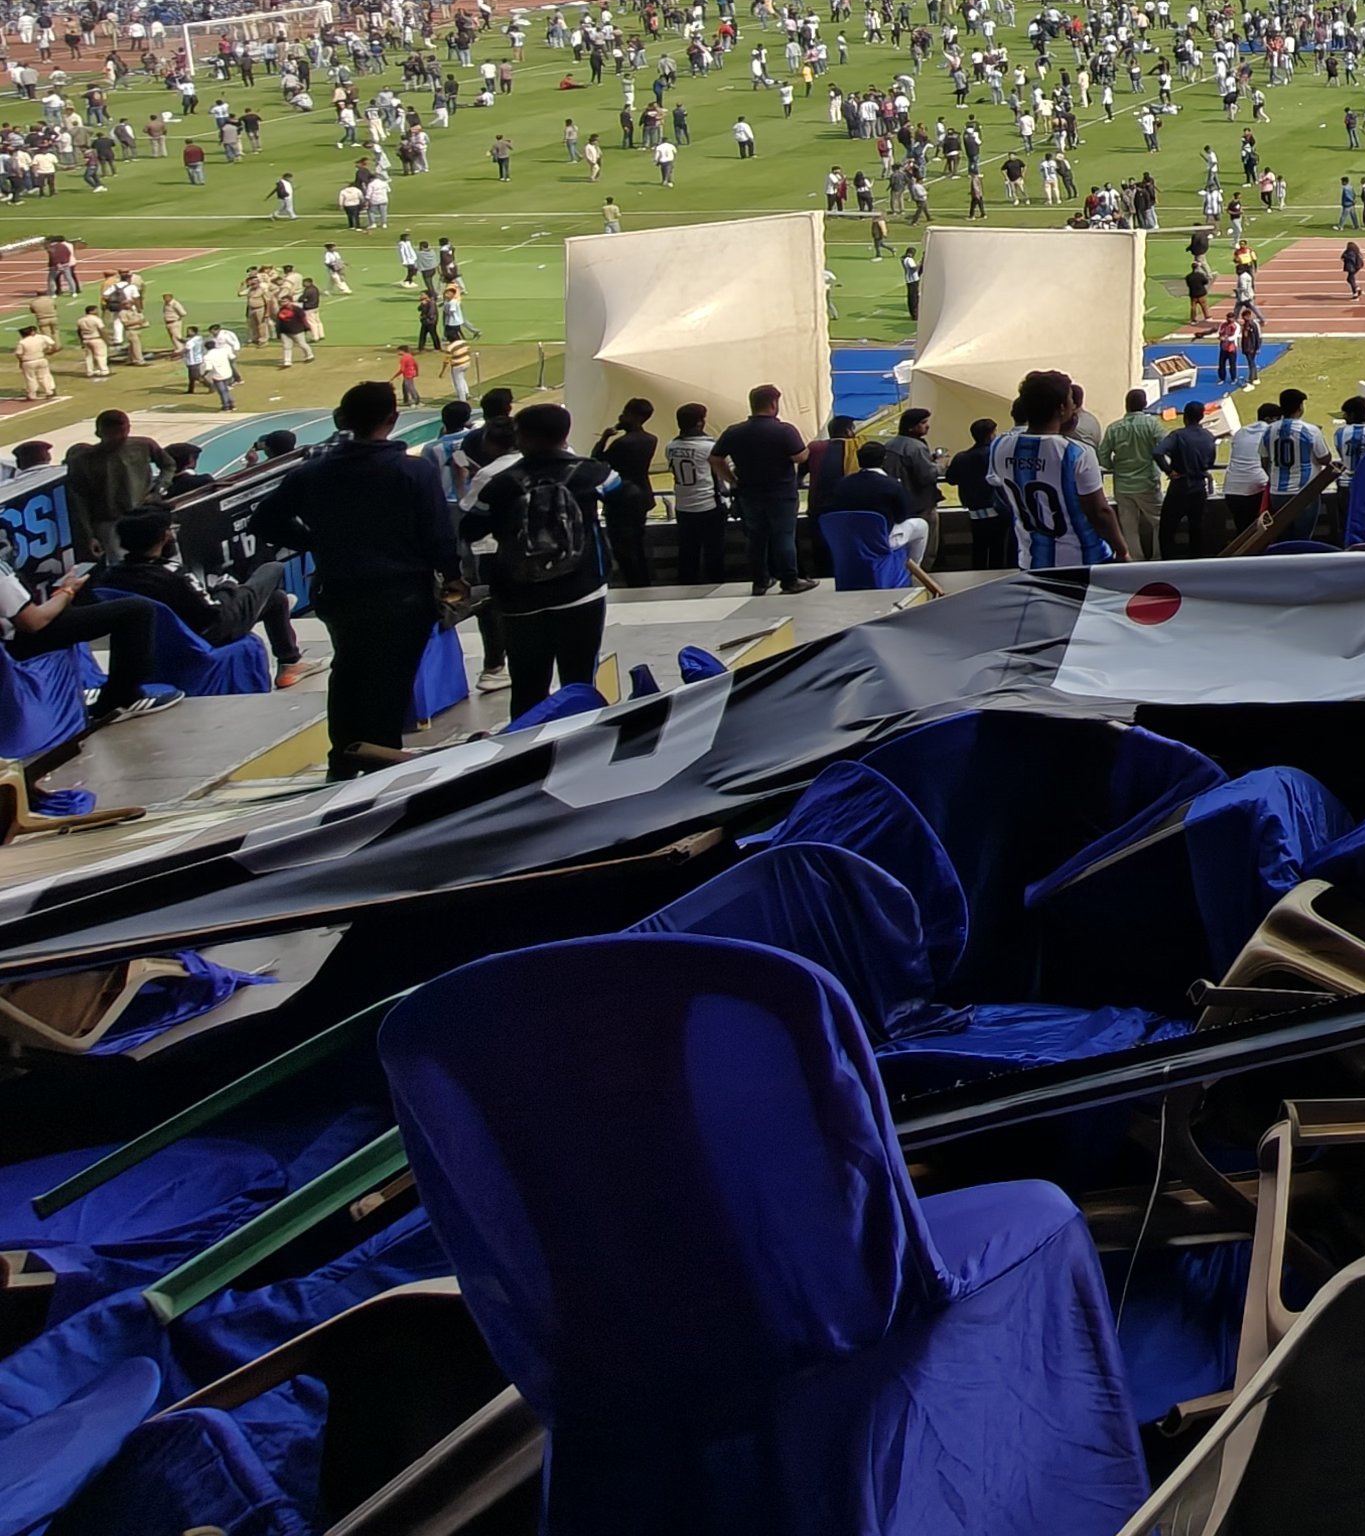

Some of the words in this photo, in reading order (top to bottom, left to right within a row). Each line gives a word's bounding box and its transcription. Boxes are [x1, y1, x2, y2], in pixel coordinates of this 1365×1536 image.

[1005, 457, 1046, 472] MESSI
[1274, 438, 1296, 467] 10
[1003, 478, 1068, 539] 10
